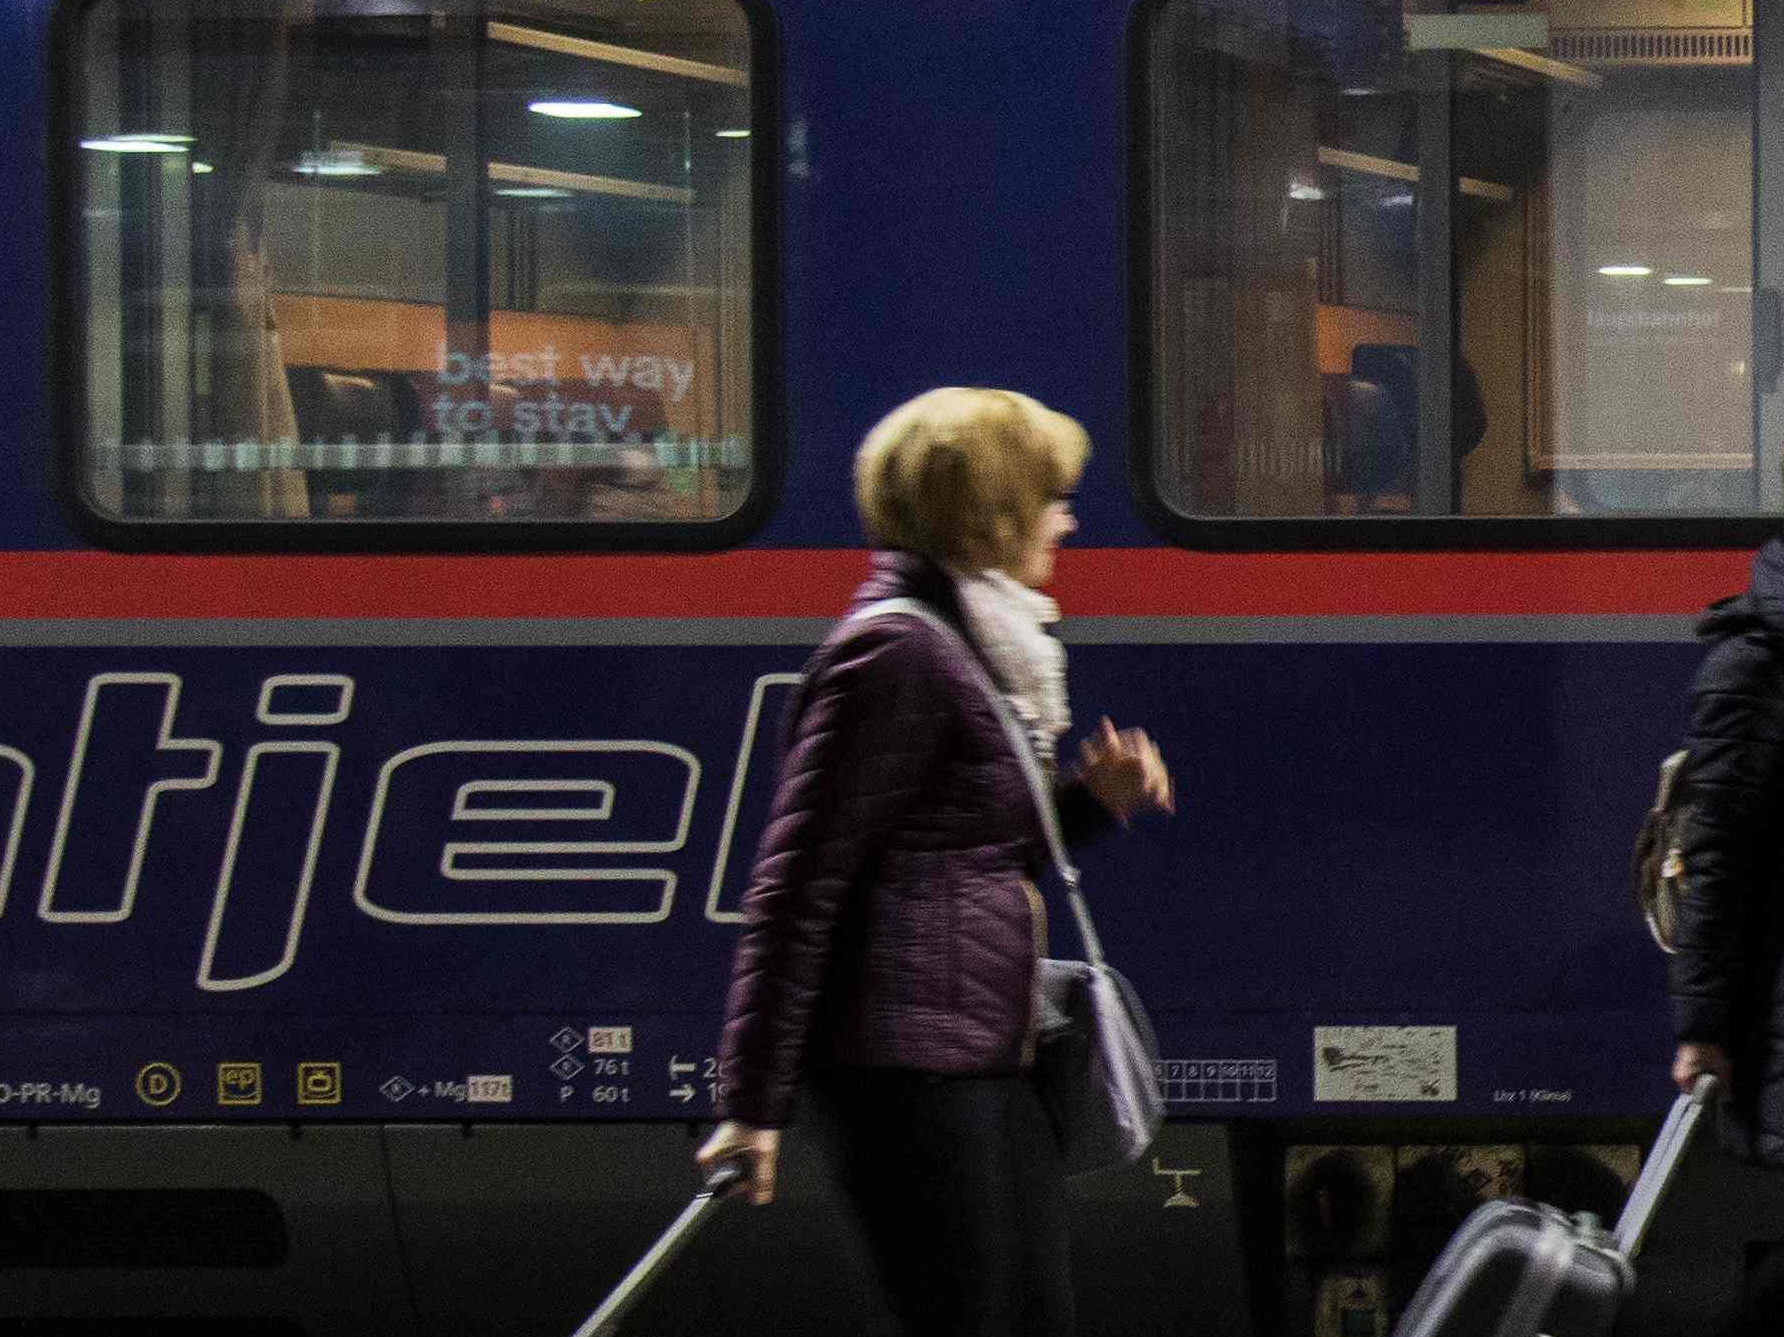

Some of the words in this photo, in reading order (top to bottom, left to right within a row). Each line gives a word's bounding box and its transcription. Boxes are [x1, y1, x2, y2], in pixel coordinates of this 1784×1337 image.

[436, 343, 557, 387] best
[580, 354, 695, 403] way
[433, 393, 492, 432] to
